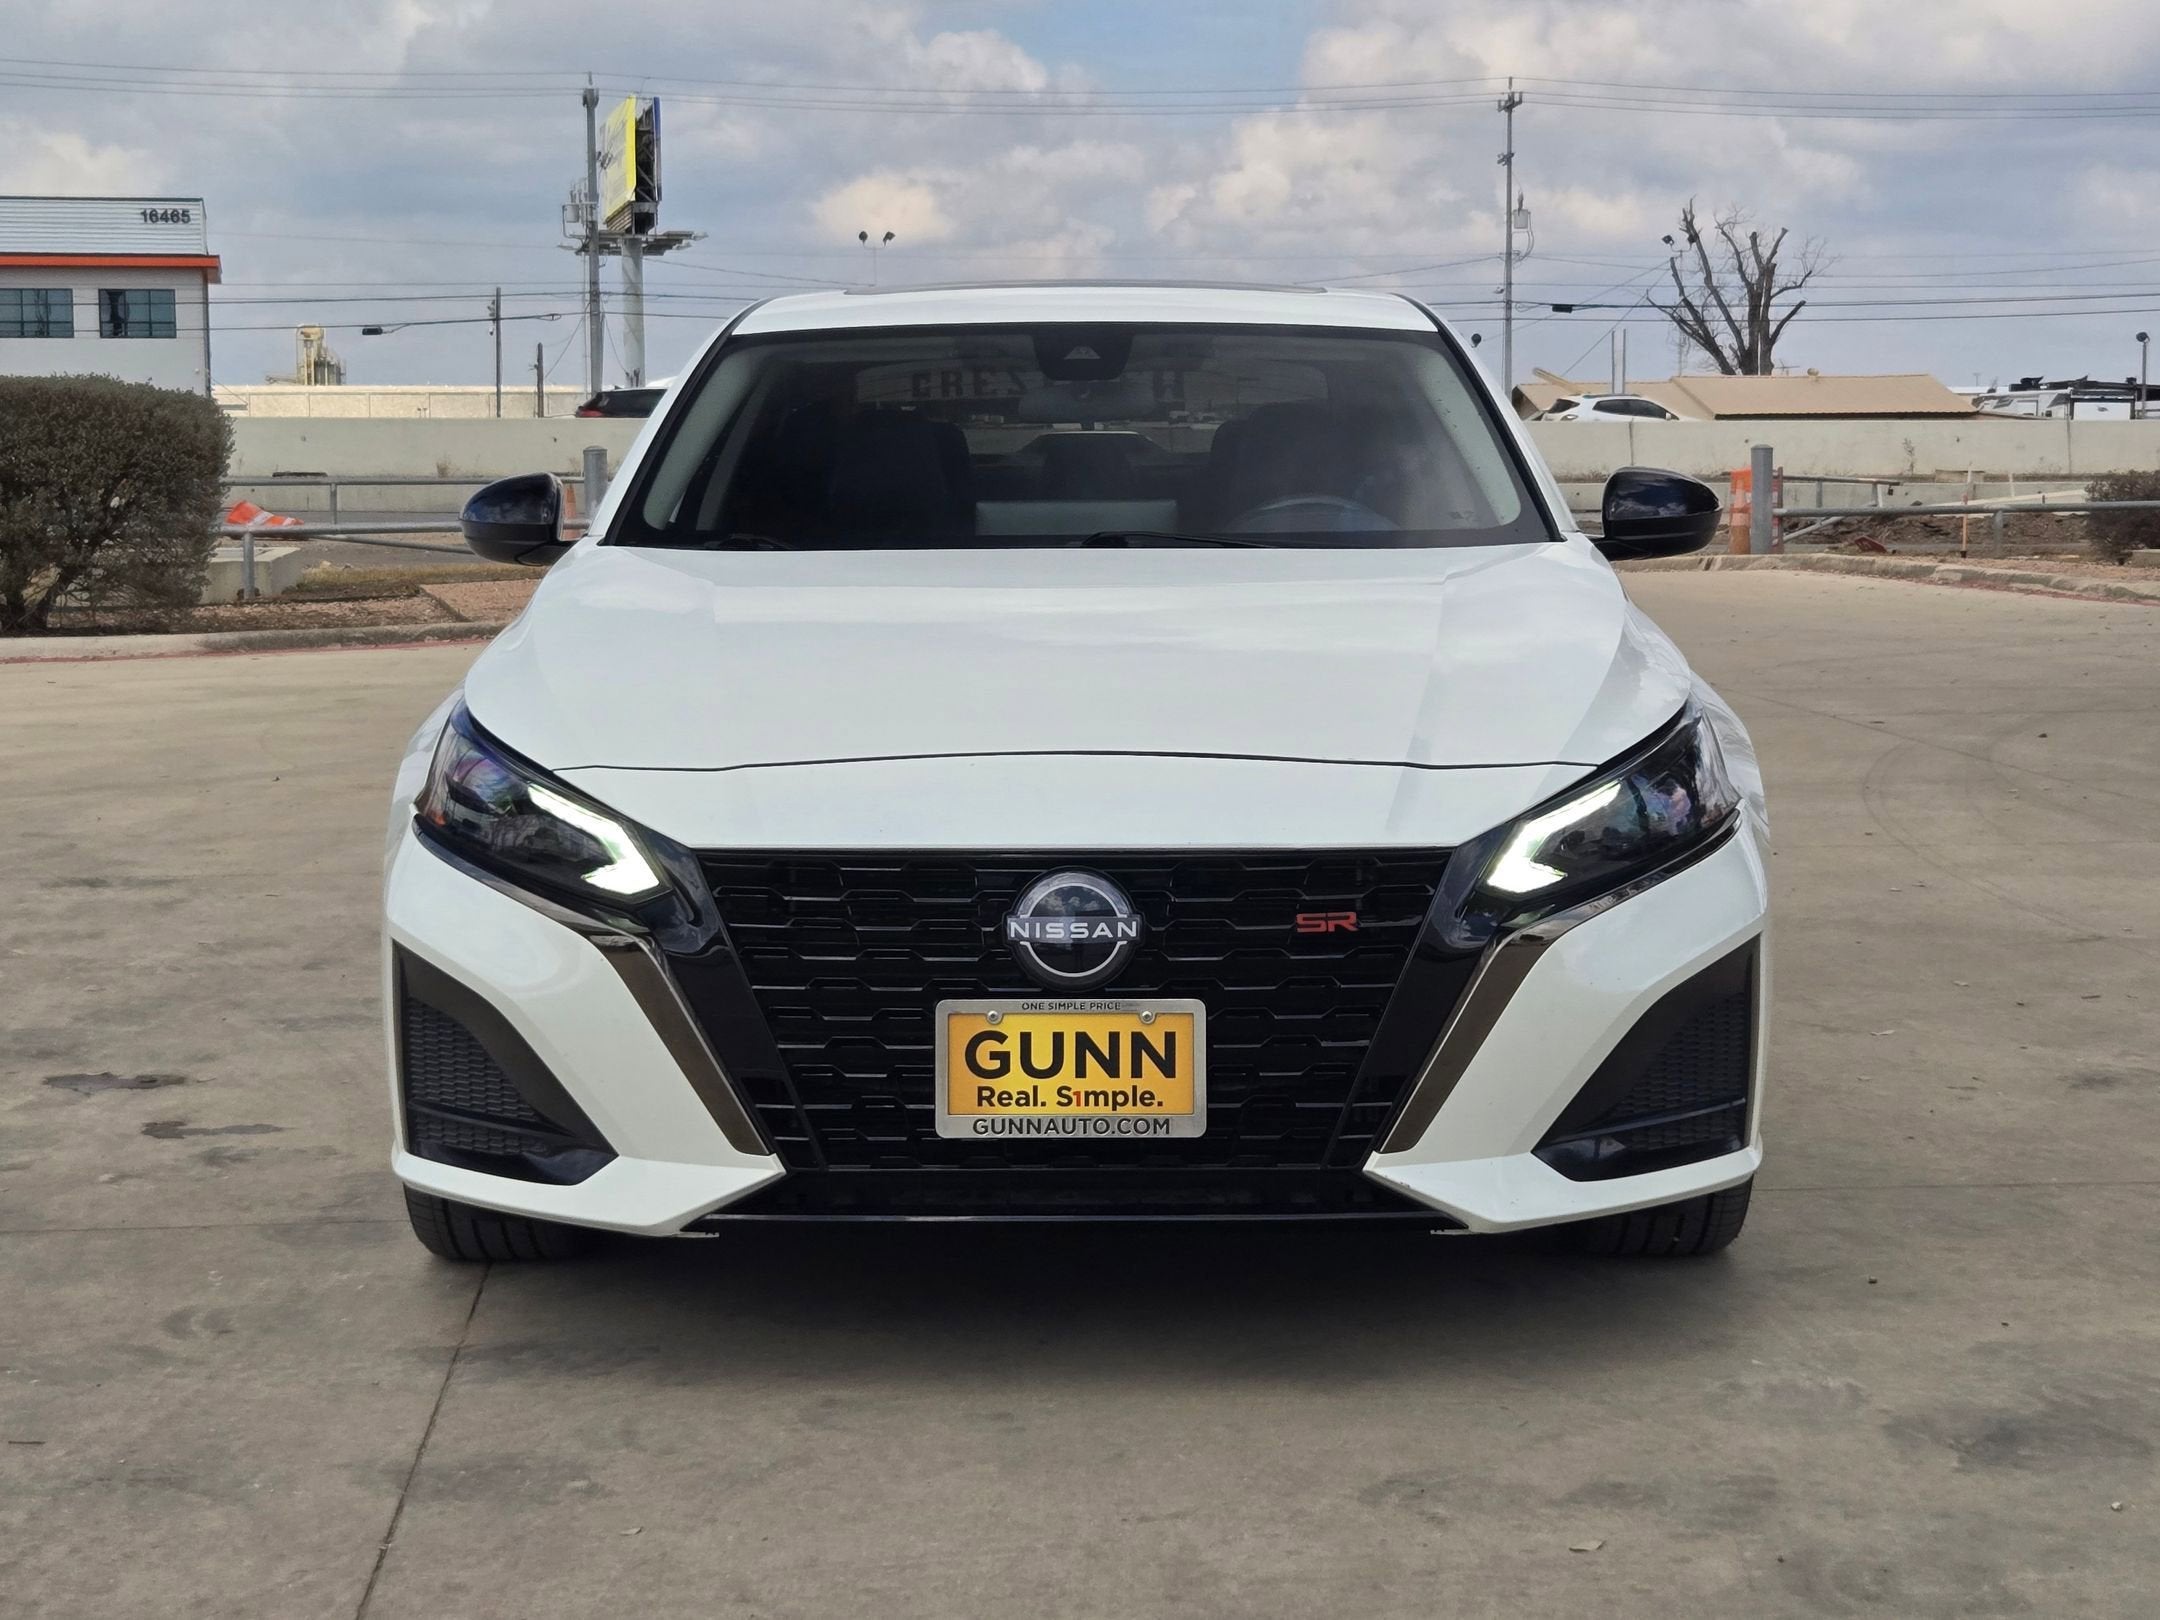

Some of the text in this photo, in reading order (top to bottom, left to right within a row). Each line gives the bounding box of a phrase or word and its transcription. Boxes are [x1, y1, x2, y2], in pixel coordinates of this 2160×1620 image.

[140, 208, 191, 224] 16465
[1010, 921, 1137, 939] NISSAN
[1296, 911, 1359, 932] SR
[1021, 1002, 1121, 1011] ONE SIMPLE PRICE
[964, 1030, 1177, 1080] GUNN
[976, 1085, 1047, 1107] Real.
[972, 1118, 1170, 1136] GUNNAUTO.COM
